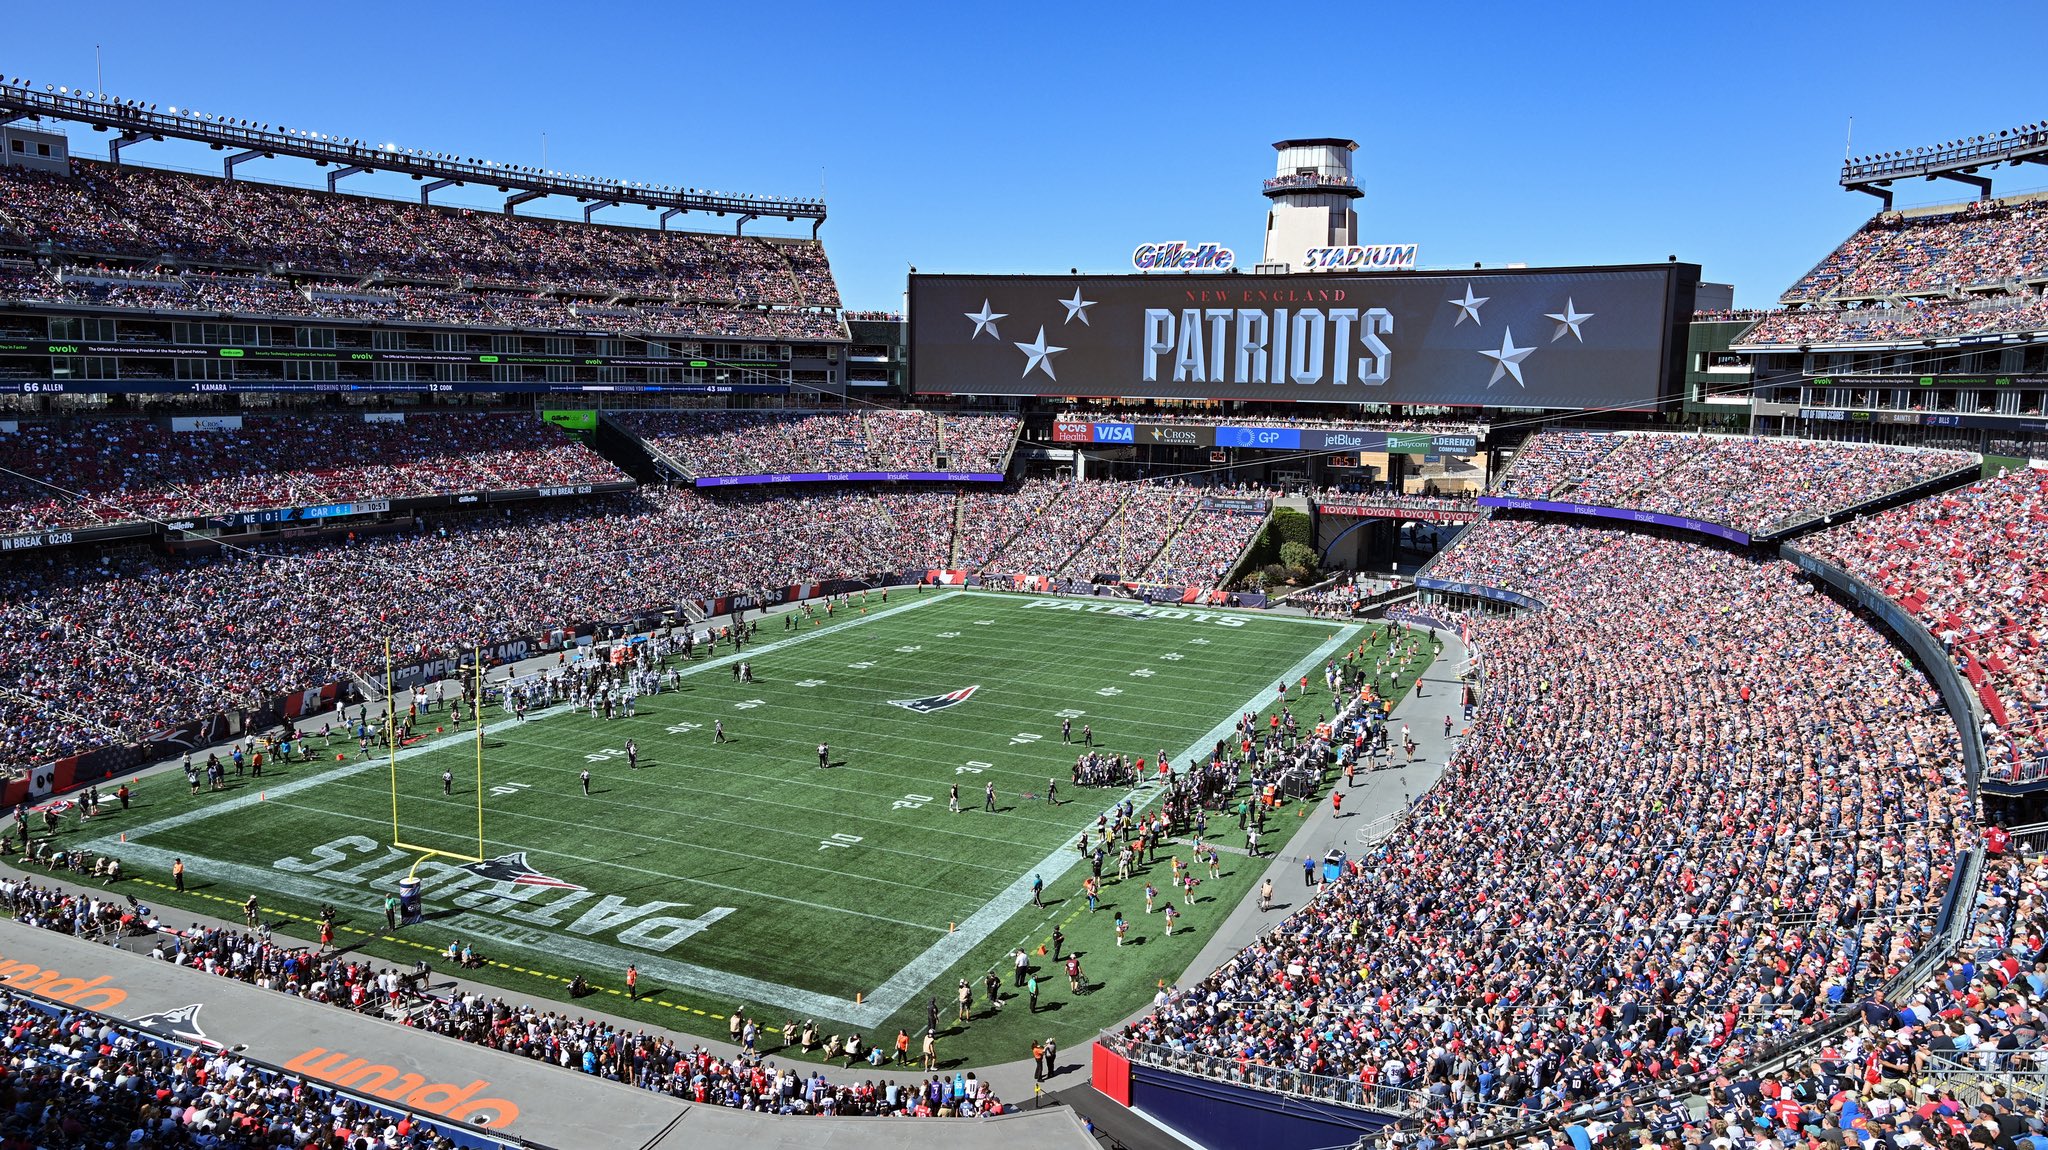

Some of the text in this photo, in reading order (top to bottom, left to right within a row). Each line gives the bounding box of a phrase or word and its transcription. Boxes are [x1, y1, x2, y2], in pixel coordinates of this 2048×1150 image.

[1134, 242, 1417, 270] Gillette STADIUM
[1186, 290, 1346, 302] NEW ENGLAND
[1143, 308, 1394, 386] PATRIOTS
[24, 383, 64, 392] 66 ALLEN
[1828, 410, 1844, 419] SCORES
[1067, 424, 1087, 433] CVS
[1096, 426, 1133, 440] VISA
[1164, 428, 1196, 439] CROSS
[1324, 434, 1361, 447] jetBlue
[1398, 441, 1428, 449] paycom
[1432, 438, 1476, 446] J.DERENZO
[1212, 452, 1224, 461] 25
[1332, 457, 1356, 466] 10:51
[720, 477, 738, 485] Insulet
[1508, 500, 1532, 509] Insulet
[311, 508, 328, 517] CAR
[1324, 506, 1358, 515] TOYOTA
[1362, 508, 1396, 517] TOYOTA
[1400, 510, 1435, 519] TOYOTA
[1575, 505, 1596, 515] Insulet
[1438, 512, 1475, 521] TOYOTA
[1634, 512, 1654, 523] Insulet
[168, 522, 194, 530] Gillette
[2, 532, 72, 549] IN BREAK 02:03
[1020, 600, 1250, 627] PATRIOTS
[423, 658, 458, 678] NEW
[460, 640, 527, 664] ENGLAND
[1010, 733, 1043, 744] 40
[956, 761, 993, 774] 30
[489, 782, 531, 794] 10
[893, 794, 933, 809] 20
[820, 833, 863, 849] 10
[1300, 1061, 1308, 1070] 75
[284, 1047, 520, 1129] Optum
[675, 1082, 682, 1090] 12
[1572, 1080, 1581, 1089] 10
